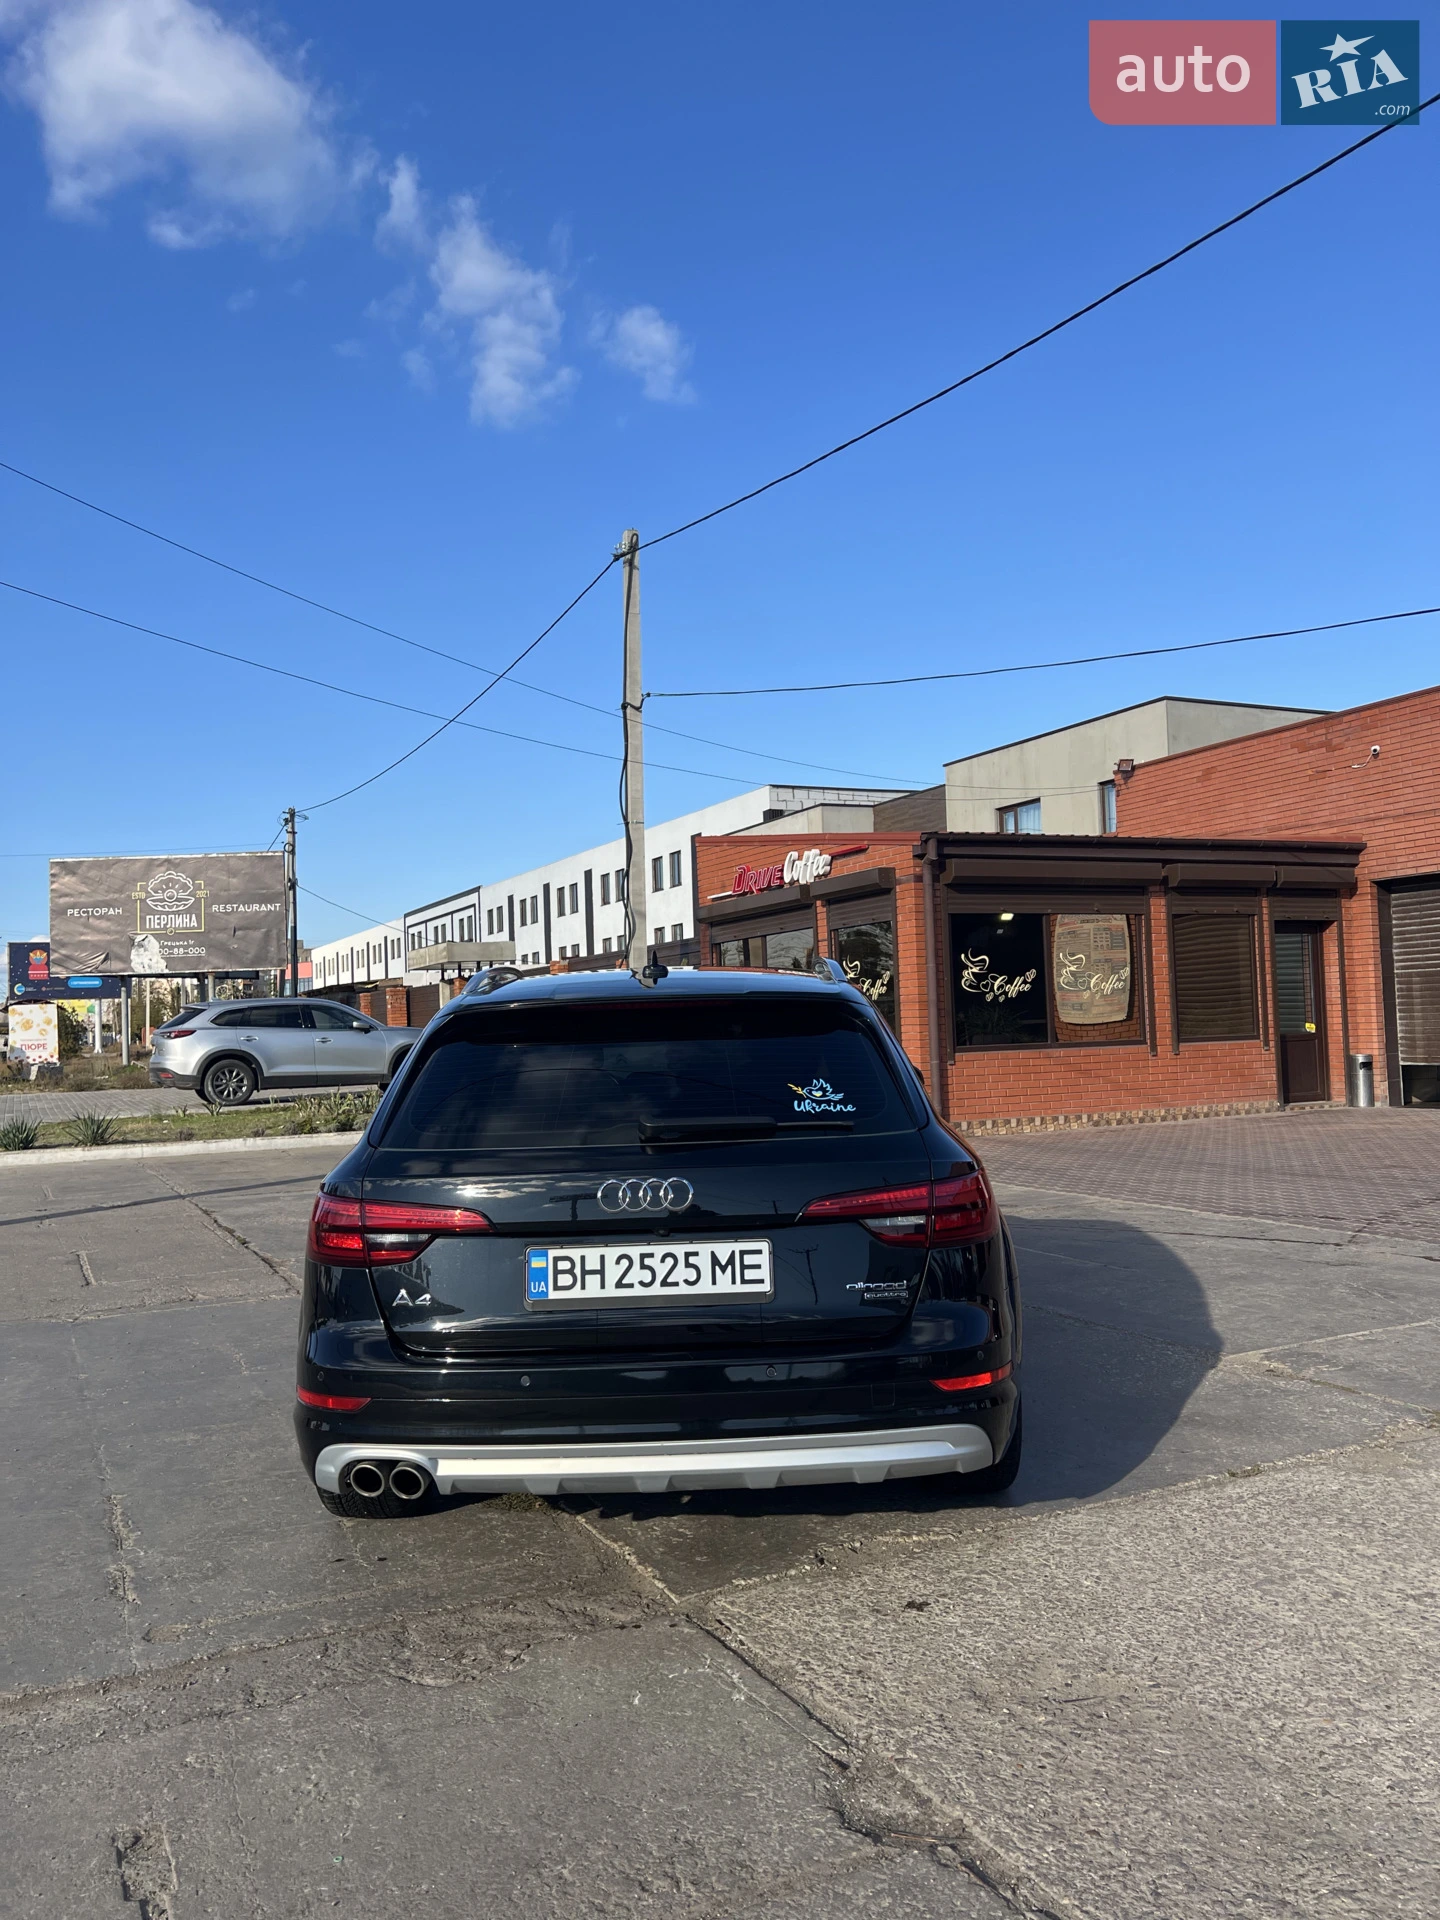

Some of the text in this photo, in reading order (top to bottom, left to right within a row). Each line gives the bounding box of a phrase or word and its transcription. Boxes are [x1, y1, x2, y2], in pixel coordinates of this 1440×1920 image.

[783, 849, 832, 884] Coffee
[131, 890, 210, 900] ESTD 2021
[67, 907, 123, 917] РЕСТОРАН
[212, 903, 282, 912] RESTAURANT
[146, 913, 198, 929] ПЕРЛИНА
[859, 976, 888, 1001] Coffee
[988, 973, 1033, 998] Coffee
[1085, 971, 1125, 995] Coffee
[20, 1042, 48, 1051] ПЮРЕ
[793, 1099, 857, 1114] Ukraine
[552, 1249, 766, 1291] BH 2525 ME
[530, 1282, 547, 1293] UA
[391, 1288, 432, 1307] A4
